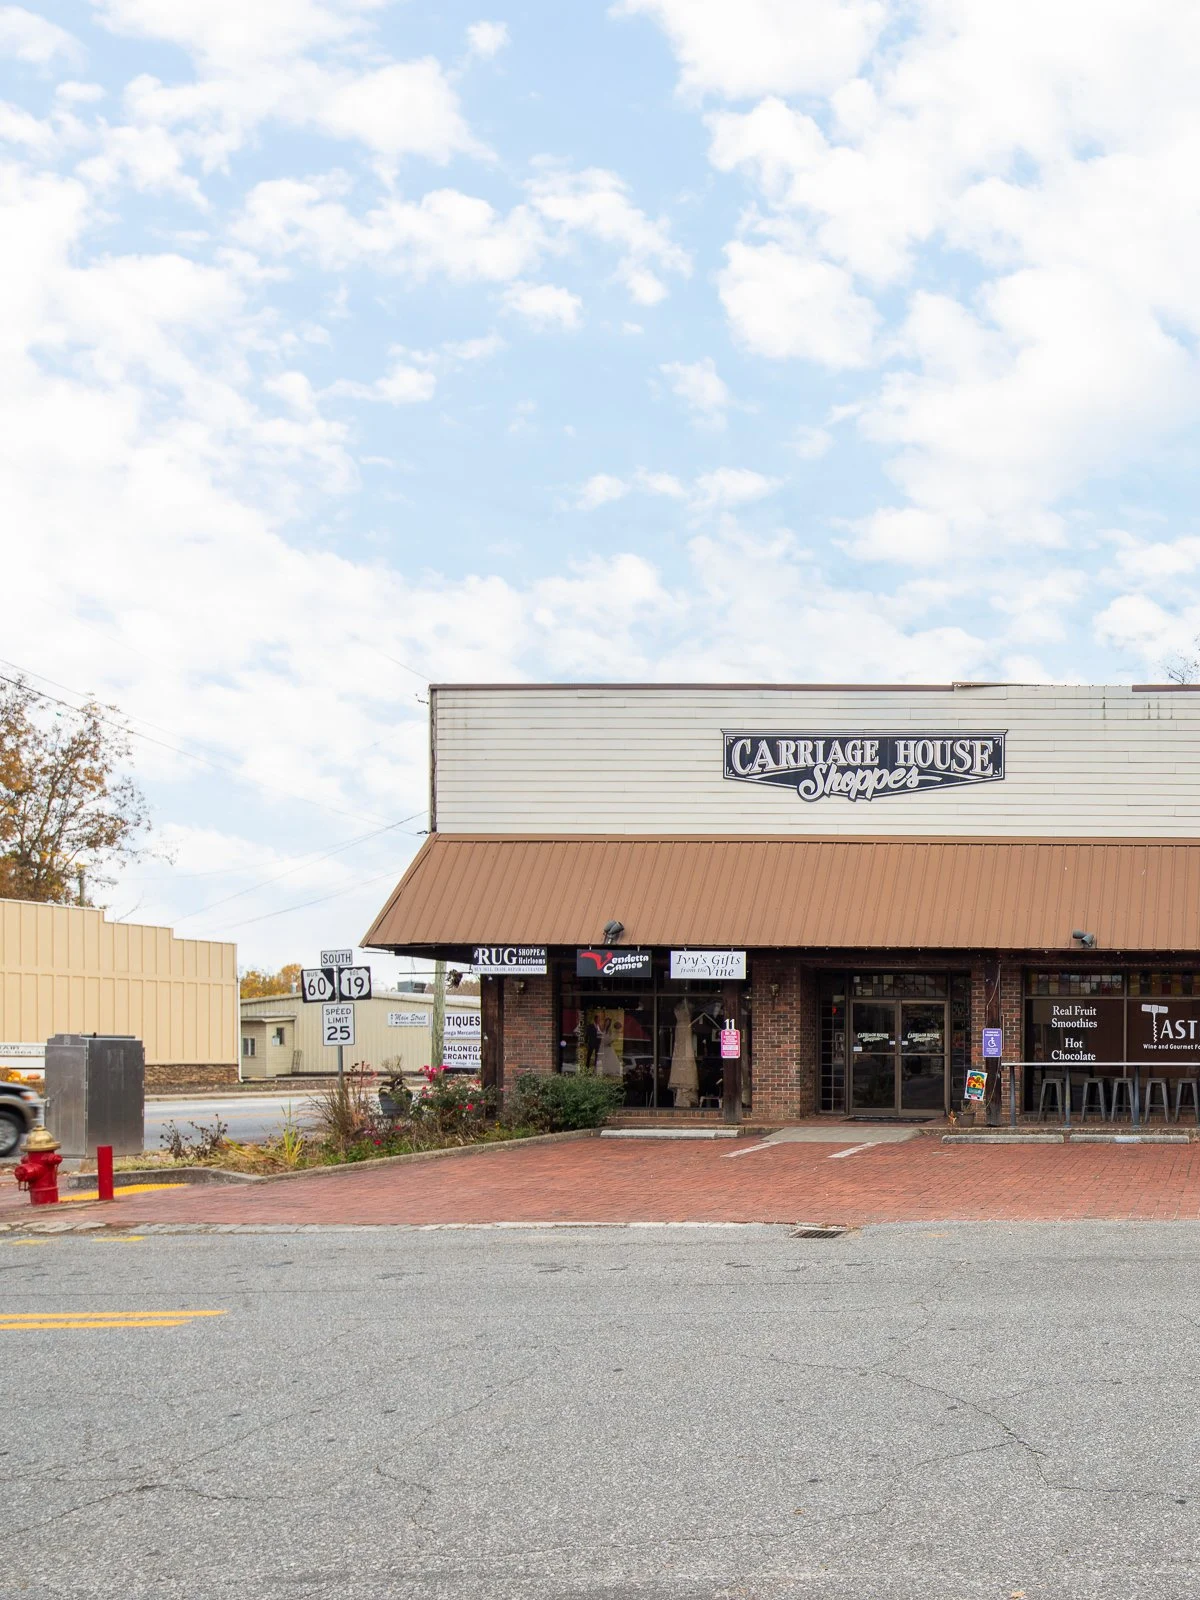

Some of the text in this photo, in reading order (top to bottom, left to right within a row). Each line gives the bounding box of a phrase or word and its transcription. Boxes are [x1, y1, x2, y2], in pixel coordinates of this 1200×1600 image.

[732, 739, 994, 777] CARRIAGE HOUSE
[798, 762, 942, 801] Shoppes
[322, 953, 352, 964] SOUTH
[477, 947, 518, 965] RUG
[518, 948, 540, 956] SHOPPE
[540, 948, 546, 956] &
[518, 956, 546, 965] Heirlooms
[580, 952, 650, 970] Vendetta
[675, 953, 742, 969] Ivy's Gifts
[603, 961, 643, 975] Games
[706, 964, 735, 977] Vine
[307, 977, 327, 996] 60
[346, 977, 365, 996] 19
[325, 1008, 352, 1016] SPEED
[1052, 1005, 1097, 1016] Real Fruit
[328, 1016, 349, 1024] LIMIT
[444, 1015, 481, 1028] TIQUES
[724, 1018, 735, 1030] 11
[1051, 1017, 1098, 1028] Smoothies
[326, 1025, 351, 1041] 25
[1064, 1037, 1084, 1048] Hot
[1051, 1049, 1097, 1061] Chocolate
